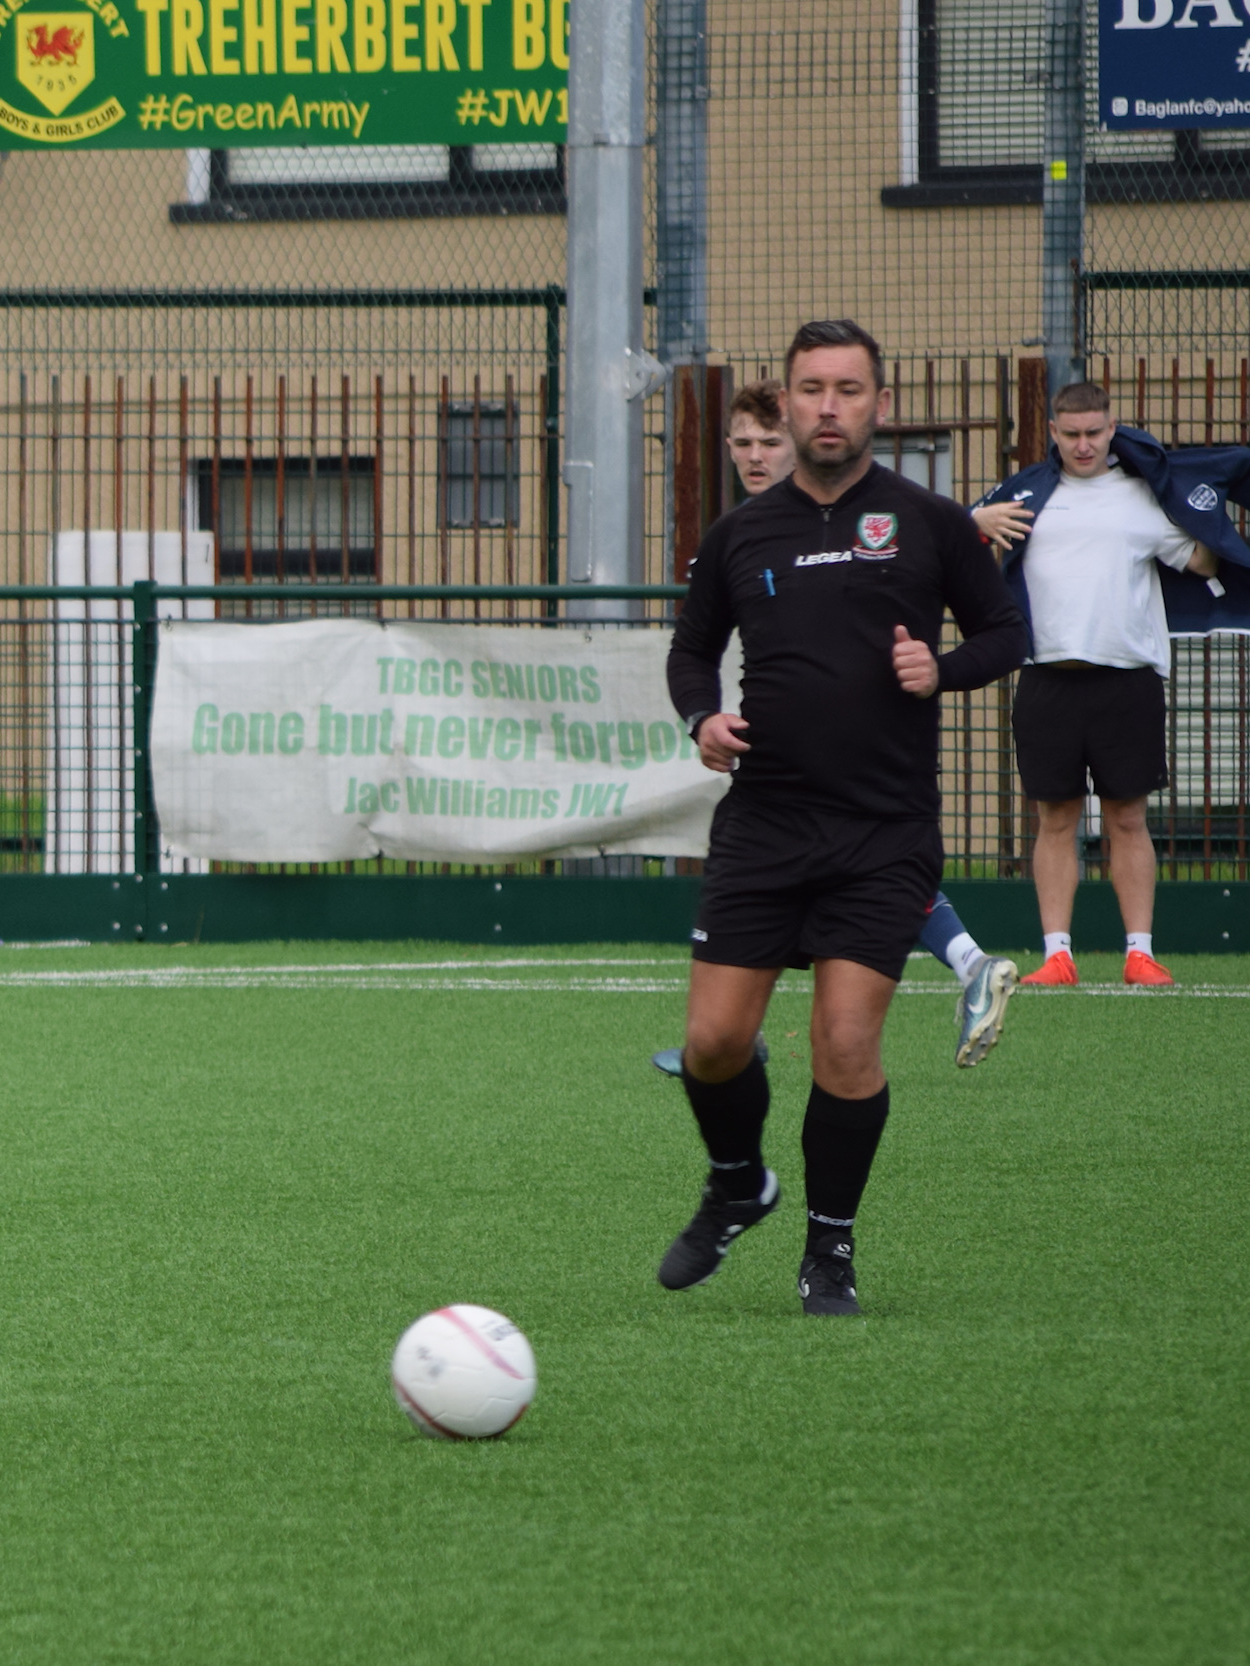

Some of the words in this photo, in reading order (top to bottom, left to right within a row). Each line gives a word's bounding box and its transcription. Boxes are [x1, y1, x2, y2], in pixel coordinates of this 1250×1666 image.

[137, 0, 492, 76] TREHERBERT
[45, 122, 84, 137] GIRLS
[86, 104, 119, 130] CLUB
[139, 93, 370, 138] #GreenArmy
[794, 551, 852, 567] LEGEA
[377, 656, 464, 696] TBGC
[471, 663, 602, 704] SENIORS
[192, 702, 305, 756] Gone
[317, 703, 395, 757] but
[406, 714, 539, 762] never
[551, 711, 701, 771] forgot
[344, 776, 400, 815] Jac
[406, 775, 560, 820] Williams
[563, 782, 629, 819] JW1
